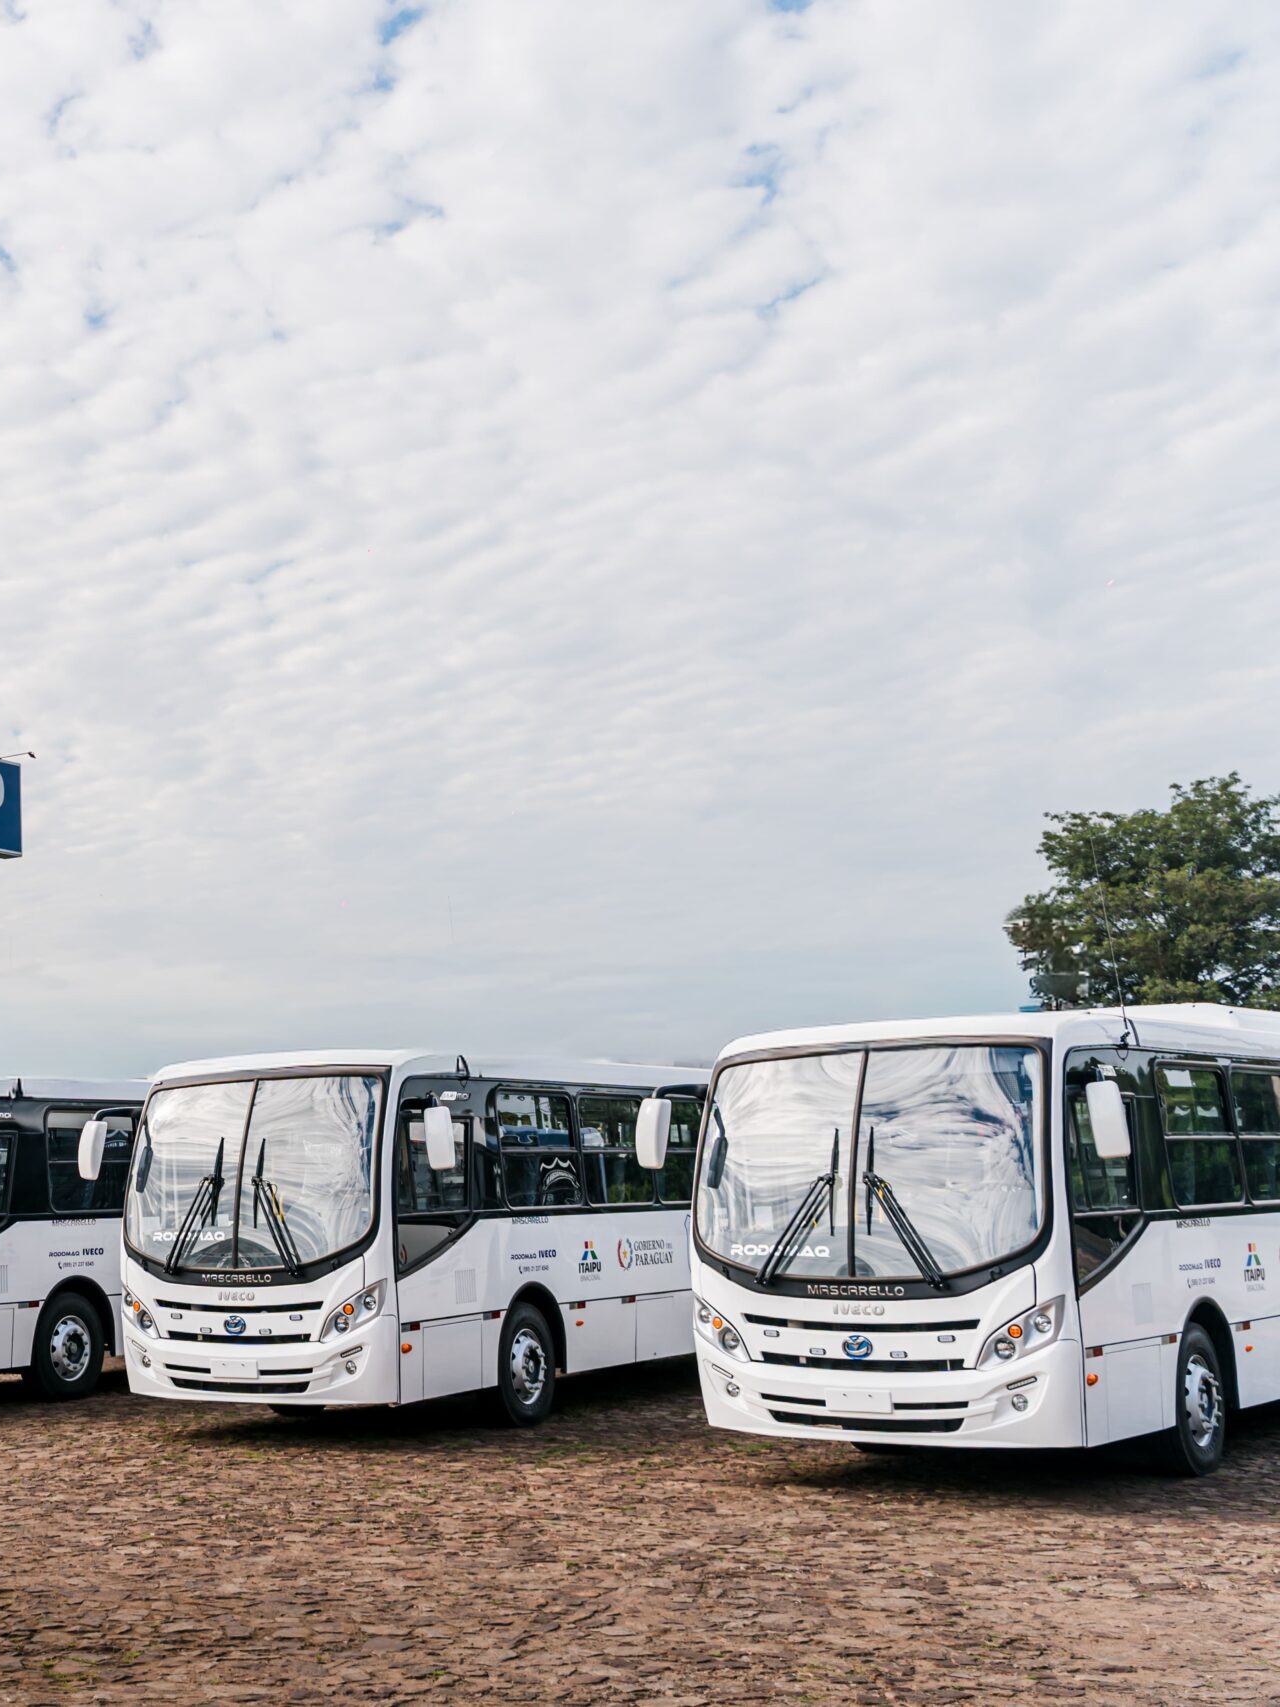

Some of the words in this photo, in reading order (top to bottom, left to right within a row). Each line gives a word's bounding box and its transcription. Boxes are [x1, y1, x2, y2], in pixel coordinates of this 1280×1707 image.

[633, 1239, 665, 1251] GOBIERNO
[82, 1247, 104, 1256] IVECO
[510, 1252, 537, 1260] RODOMAQ
[538, 1249, 557, 1259] IVECO
[635, 1251, 674, 1266] PARAGUAY
[1204, 1257, 1222, 1269] IVECO
[578, 1261, 602, 1274] ITAIPU
[201, 1273, 272, 1283] MASCARELLO
[1243, 1268, 1266, 1282] ITAIPU
[218, 1290, 255, 1301] IVECO
[807, 1284, 905, 1297] MASCARELLO
[832, 1302, 886, 1317] IVECO
